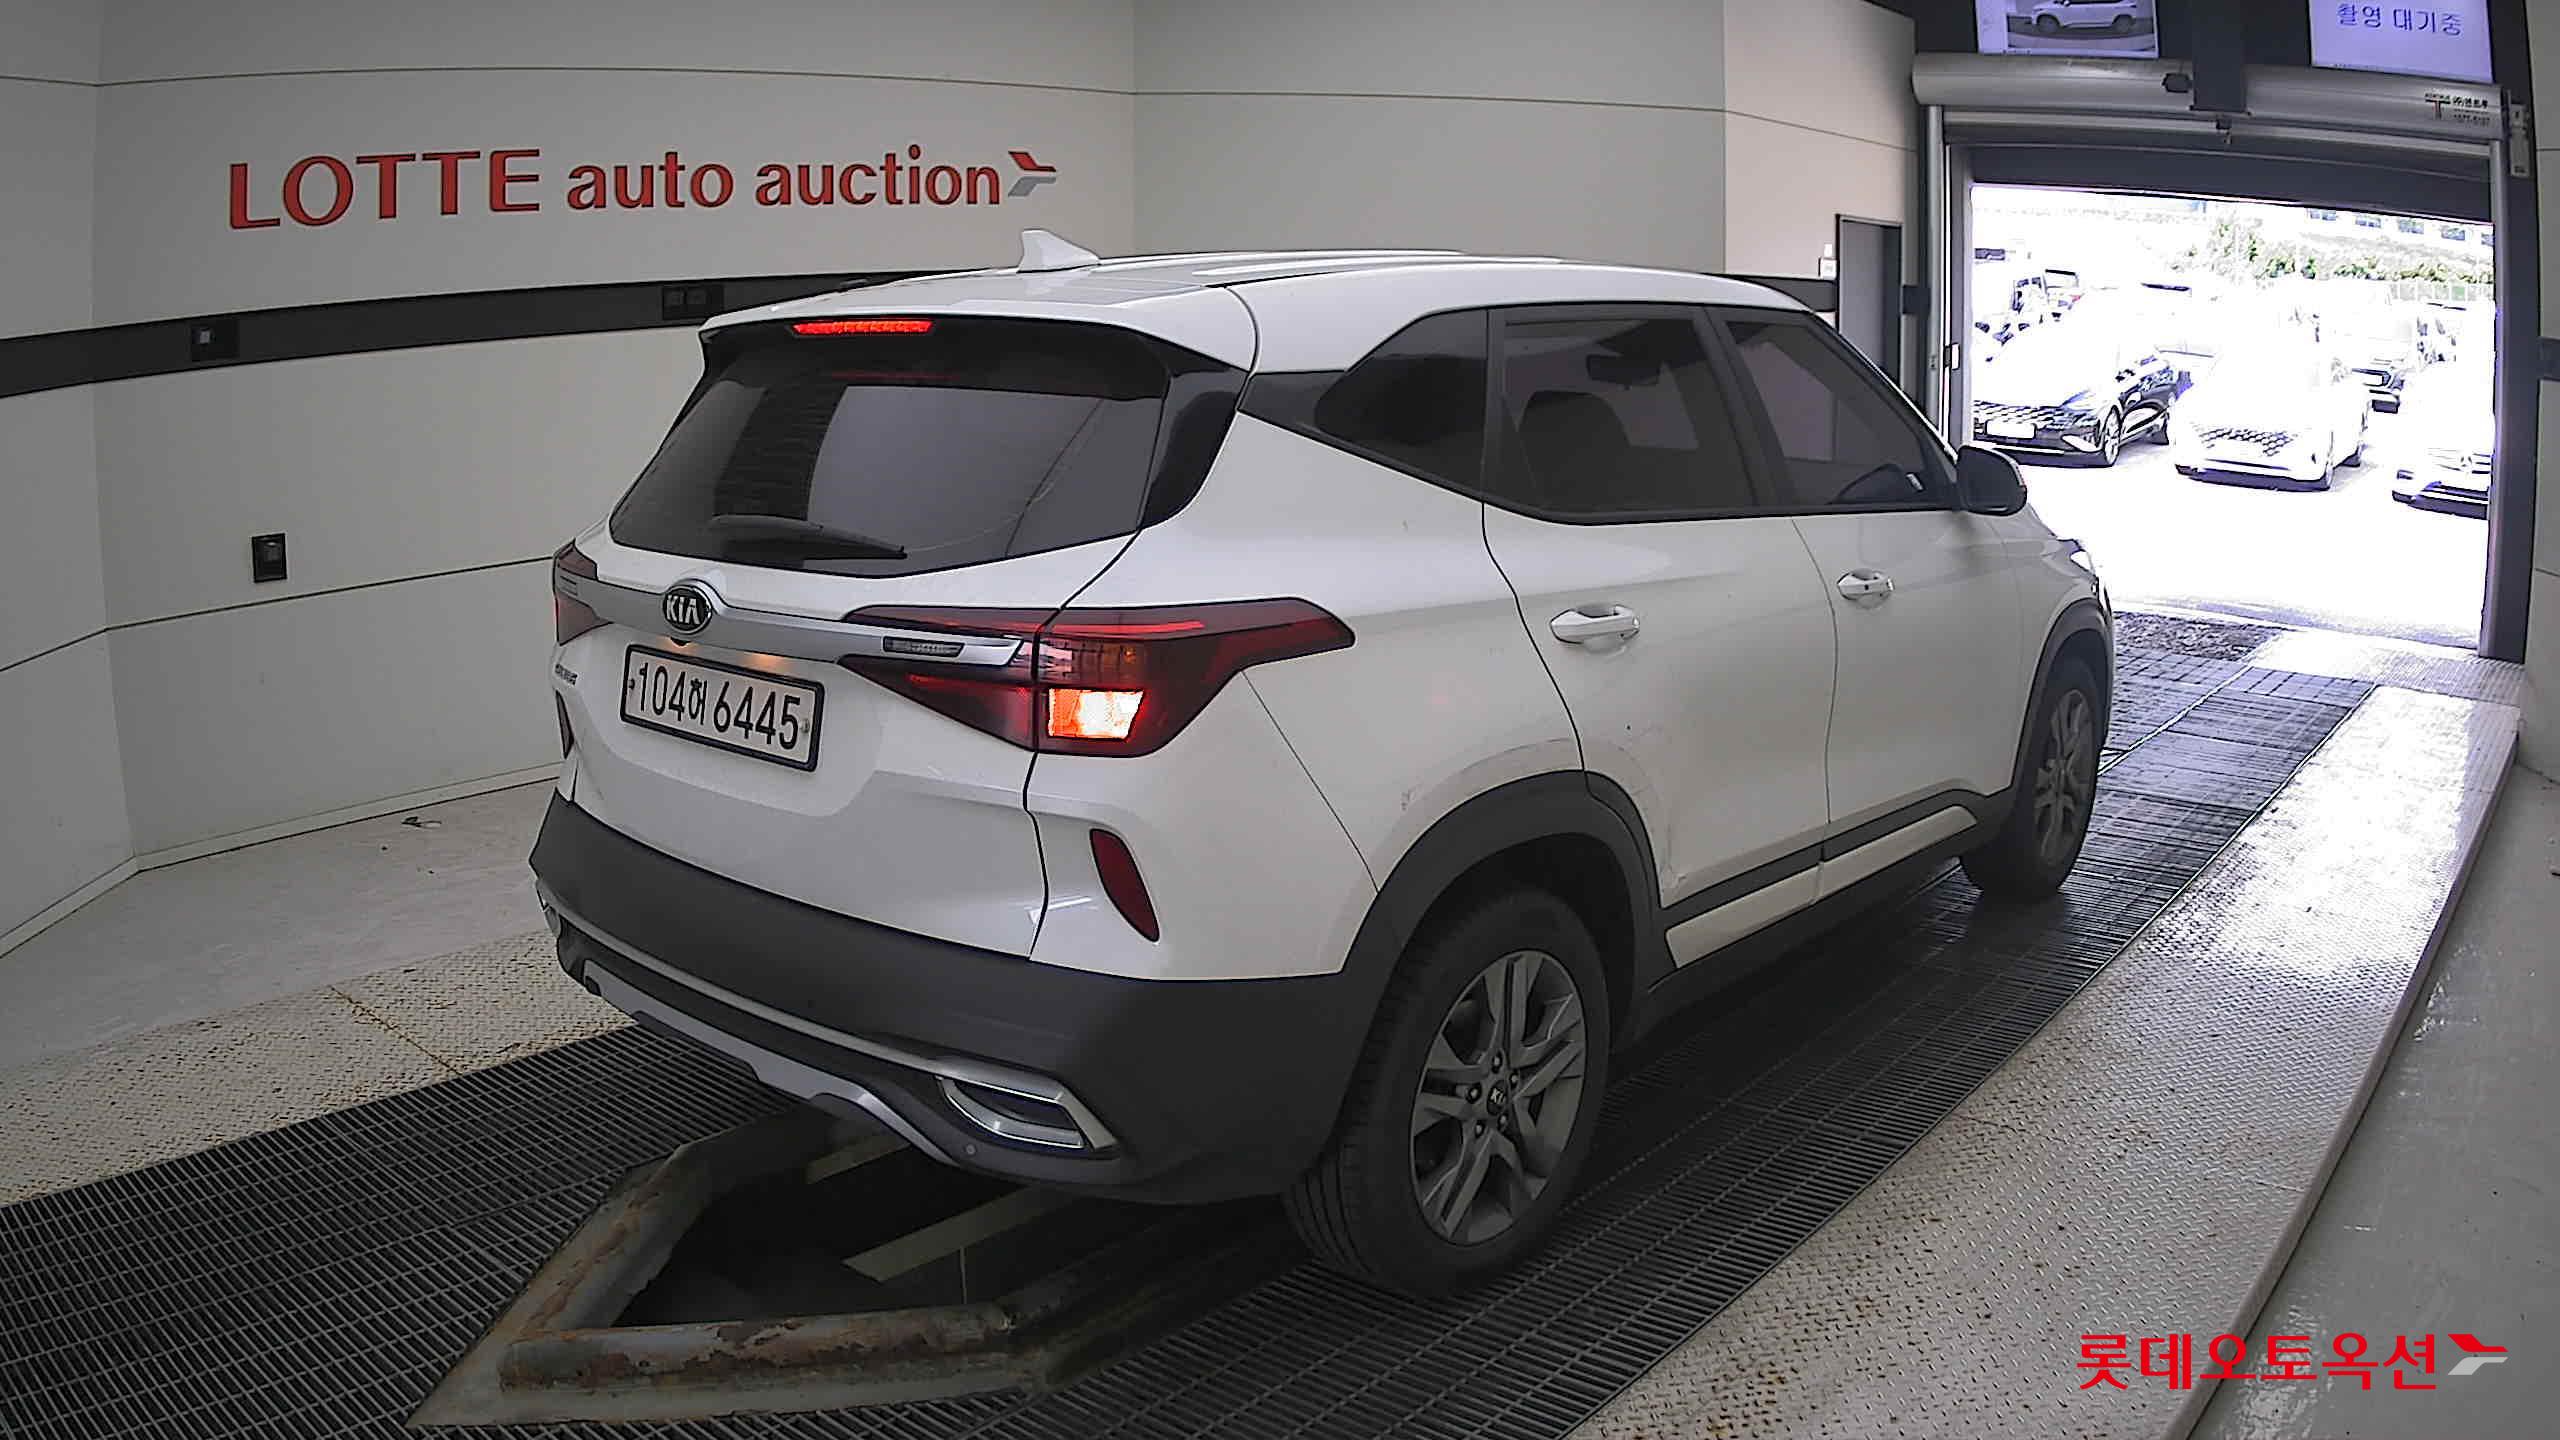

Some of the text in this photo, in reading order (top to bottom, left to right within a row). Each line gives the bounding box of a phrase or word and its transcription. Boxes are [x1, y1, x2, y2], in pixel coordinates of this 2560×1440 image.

[2337, 3, 2463, 36] 촬영 대기중
[229, 144, 1001, 230] LOTTE auto auction
[666, 594, 700, 625] KIA
[713, 680, 801, 750] 6445
